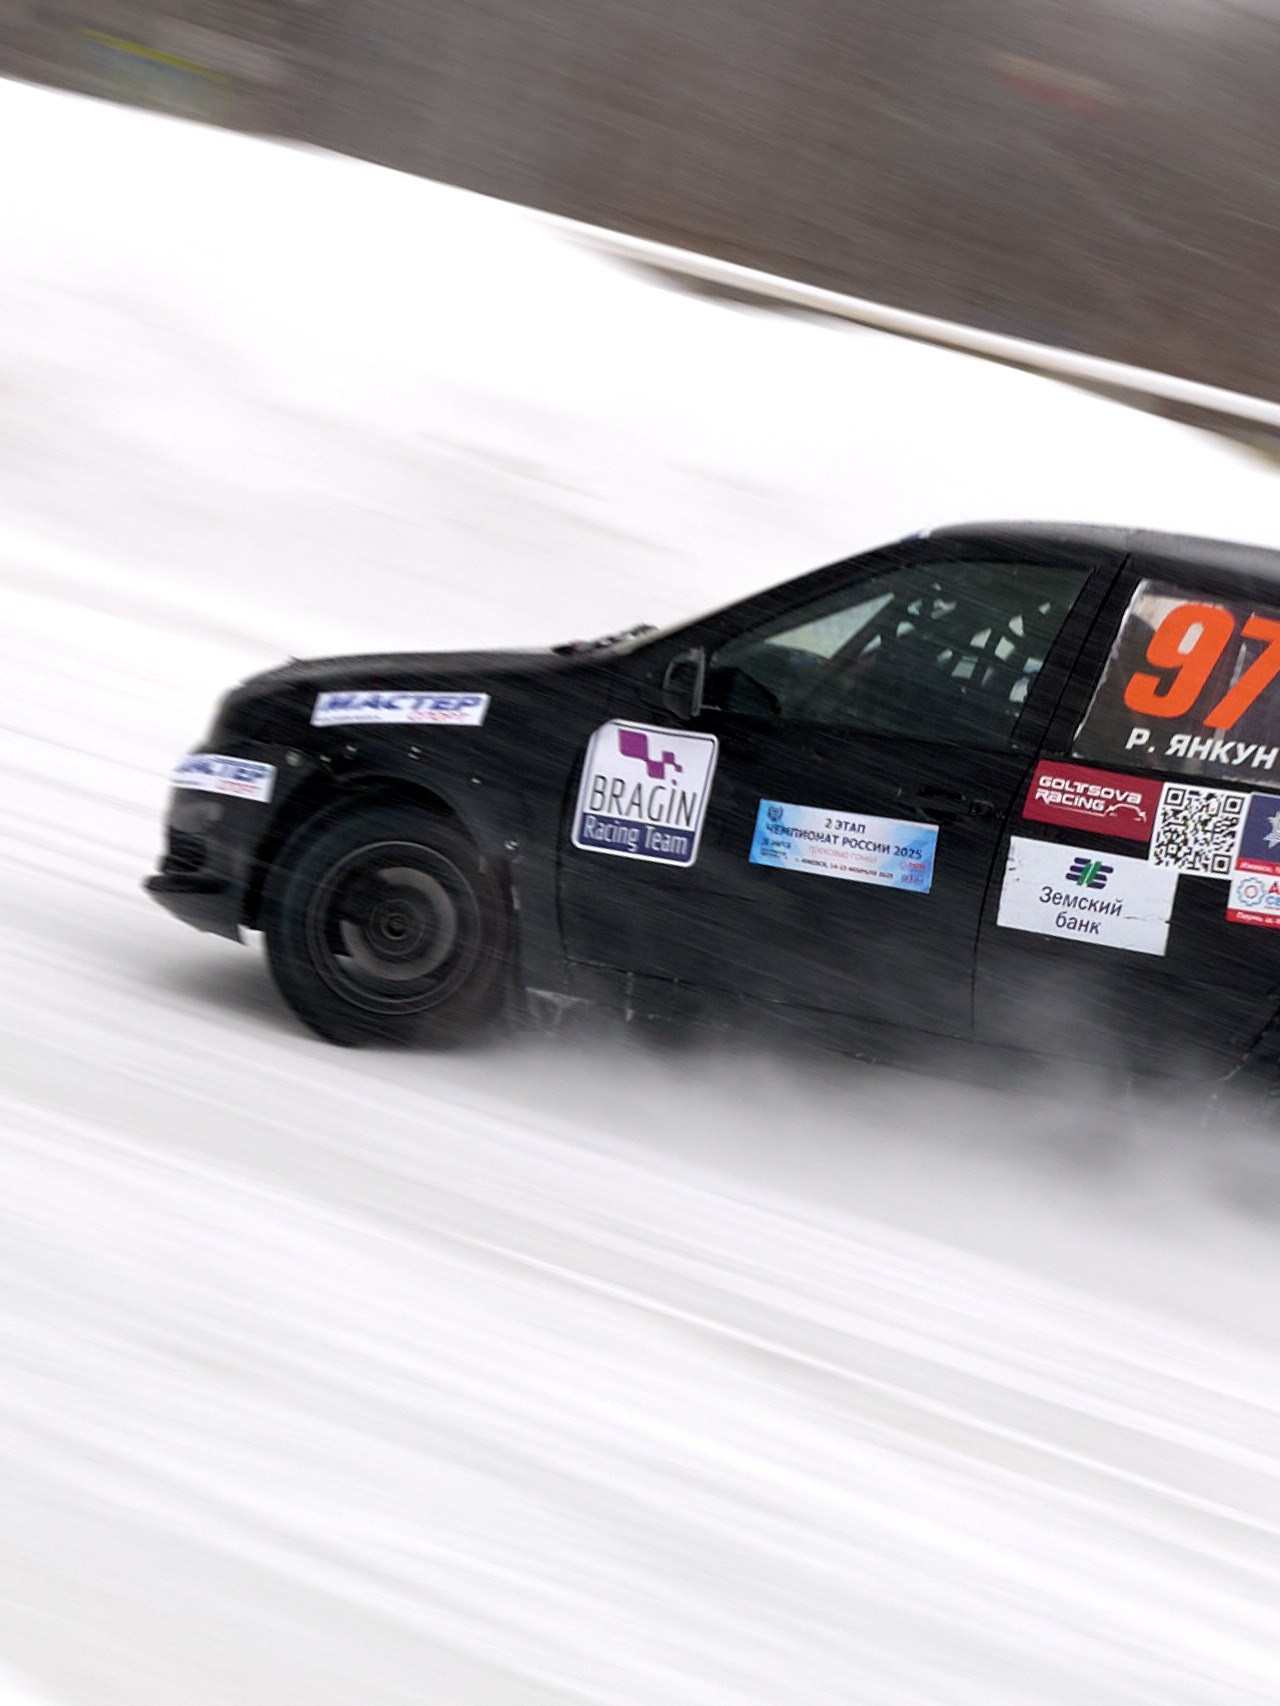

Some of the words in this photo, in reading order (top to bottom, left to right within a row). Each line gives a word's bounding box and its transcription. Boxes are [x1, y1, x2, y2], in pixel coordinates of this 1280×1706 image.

[1125, 727, 1154, 753] Р.
[1167, 733, 1280, 770] ЯНКУН
[583, 815, 641, 853] Racing
[644, 826, 688, 855] Team
[766, 823, 839, 846] ЧЕМПИОНАТ
[842, 836, 891, 855] РОССИИ
[893, 845, 923, 860] 2025
[824, 818, 833, 829] 2
[834, 821, 867, 834] ЭТАП
[1039, 886, 1123, 917] Земский
[1055, 911, 1102, 935] банк
